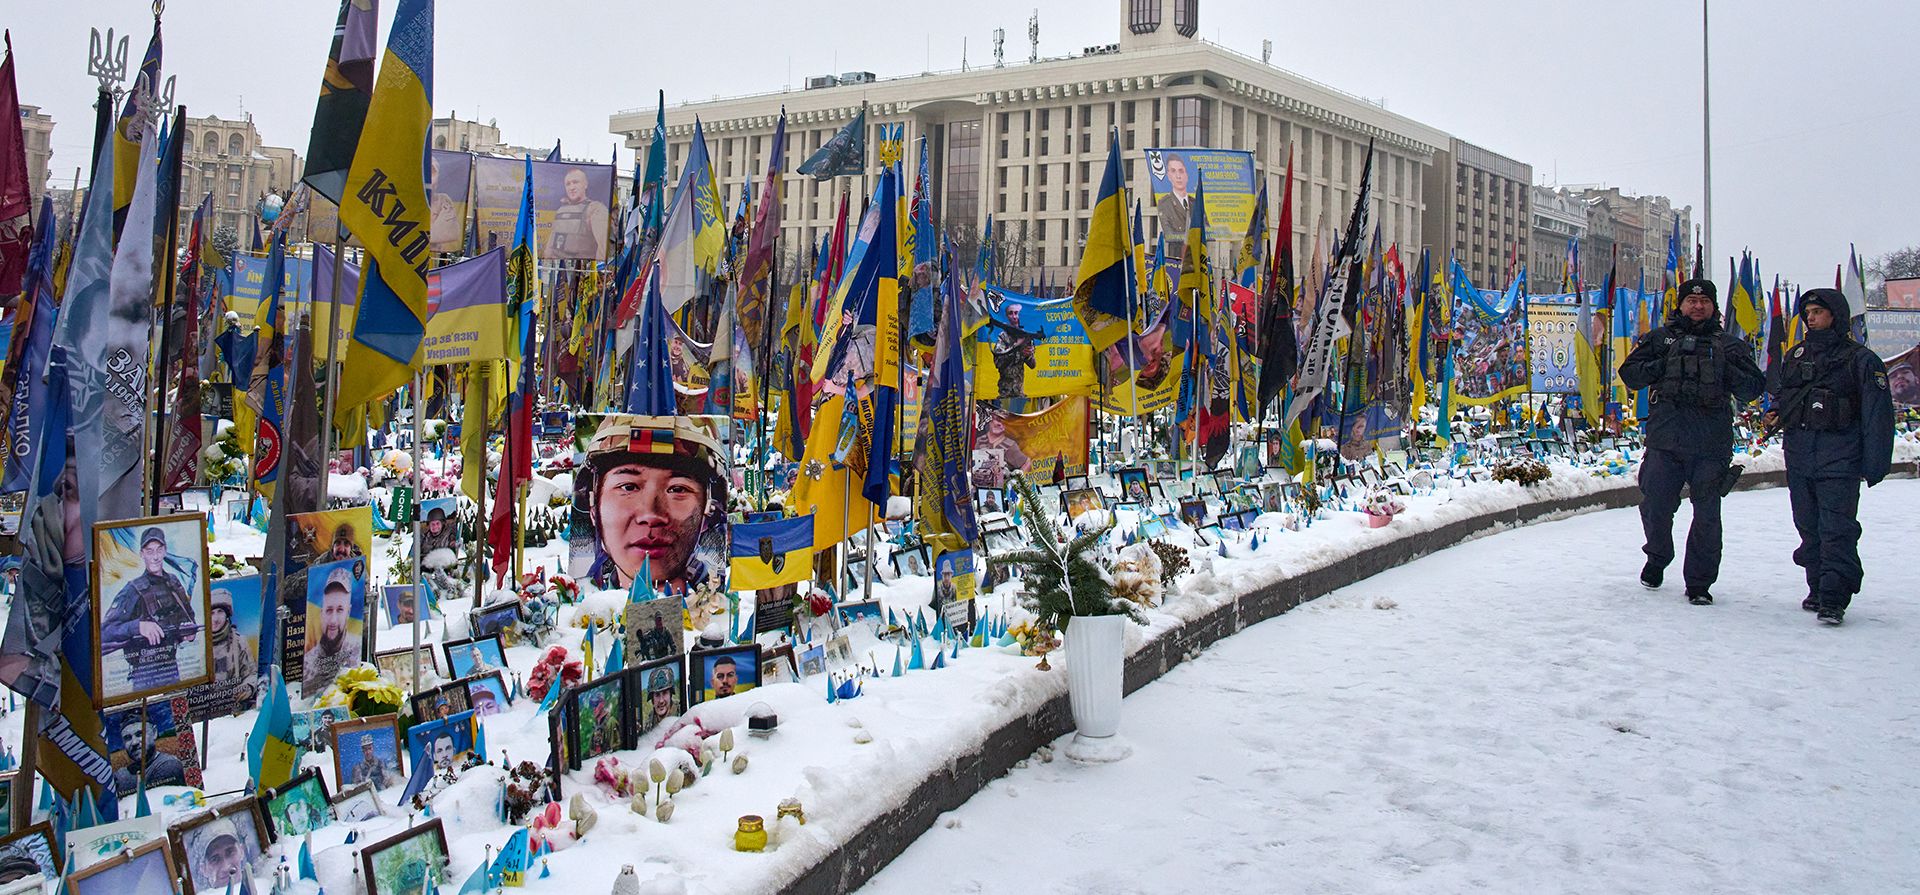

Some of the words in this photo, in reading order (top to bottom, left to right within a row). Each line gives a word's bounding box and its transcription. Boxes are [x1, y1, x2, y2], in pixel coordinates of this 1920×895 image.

[426, 347, 470, 360] України
[396, 489, 406, 520] 2025
[213, 677, 242, 688] Роман
